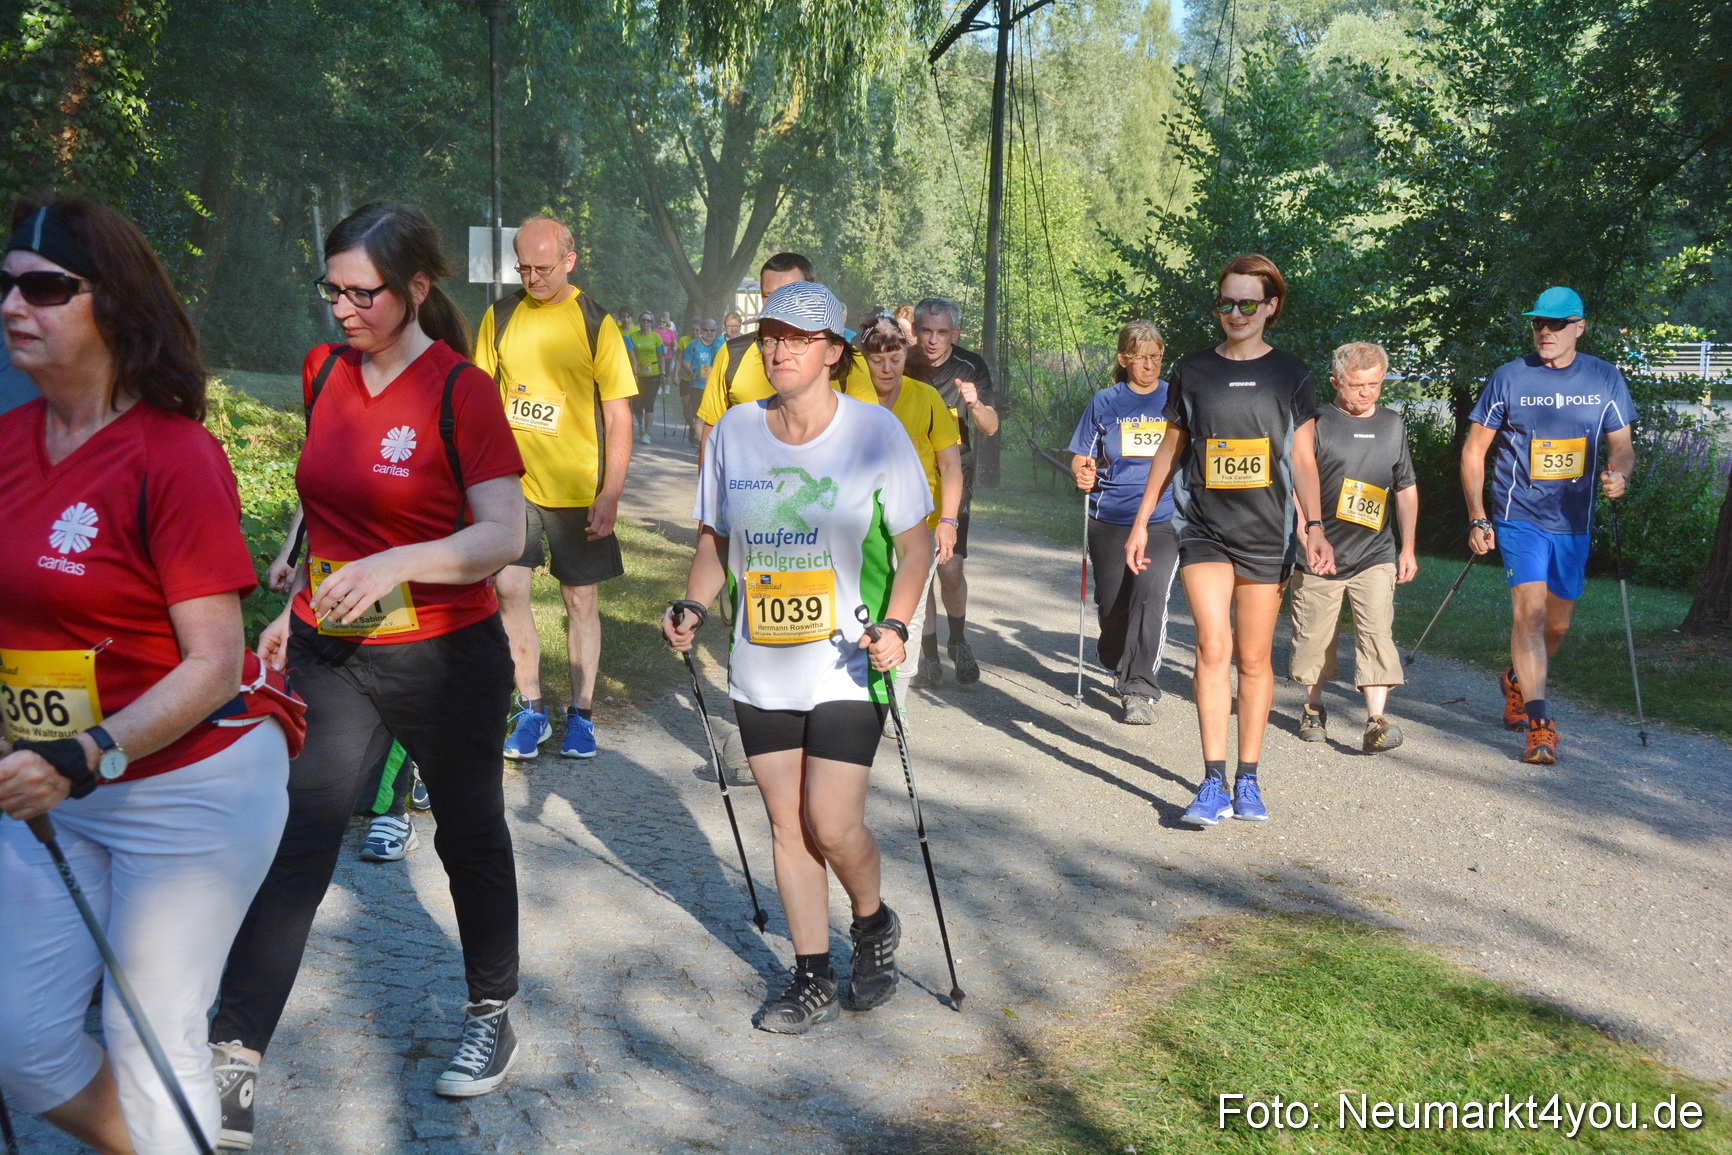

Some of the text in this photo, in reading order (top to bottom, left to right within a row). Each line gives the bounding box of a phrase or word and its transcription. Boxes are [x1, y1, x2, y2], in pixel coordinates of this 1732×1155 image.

[1520, 394, 1601, 407] EURO POLES
[512, 399, 555, 422] 1662
[1134, 433, 1162, 445] 532
[1213, 456, 1261, 475] 1646
[1543, 453, 1574, 469] 535
[372, 463, 410, 478] caritas
[729, 479, 774, 490] BERATA
[1347, 494, 1381, 517] 1684
[745, 527, 819, 548] Laufend
[38, 555, 86, 576] caritas
[756, 596, 822, 623] 1039
[360, 614, 387, 623] Sabine
[790, 622, 824, 631] Roswitha
[2, 684, 70, 727] 366
